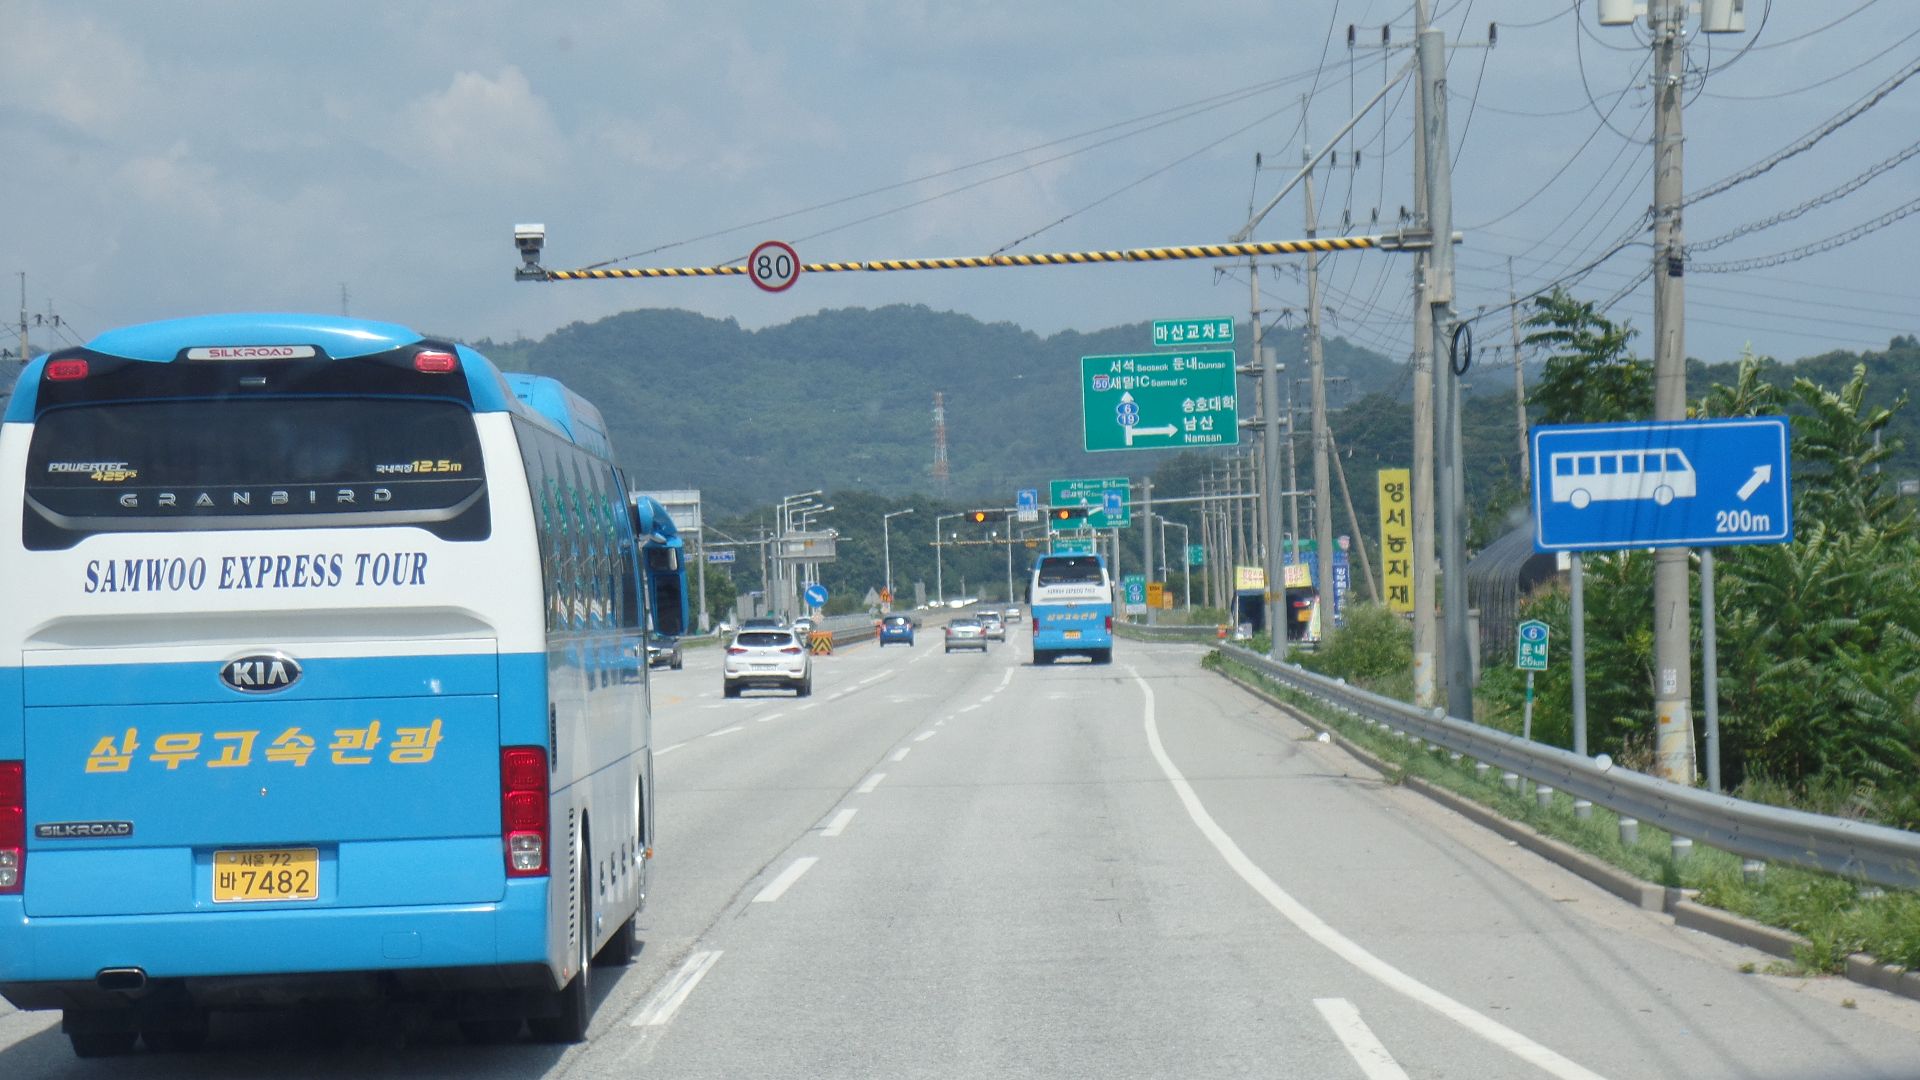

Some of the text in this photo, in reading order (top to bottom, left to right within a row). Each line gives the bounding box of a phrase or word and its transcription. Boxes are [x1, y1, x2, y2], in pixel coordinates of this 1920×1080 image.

[757, 254, 791, 280] 80
[1156, 322, 1232, 341] 마산교차로
[208, 347, 294, 359] SILKROAD
[1110, 359, 1135, 373] 서석
[1173, 357, 1198, 371] 둔내
[1095, 379, 1108, 390] 50
[1110, 375, 1150, 390] 새말IC
[1124, 403, 1132, 414] 6
[1182, 395, 1235, 413] 송호대학
[1121, 413, 1135, 422] 19
[1183, 415, 1214, 432] 남산
[1184, 433, 1222, 443] Namsan
[48, 462, 128, 473] POWERTEC
[91, 469, 138, 482] 425PS
[119, 487, 393, 508] GRANBIRD
[1716, 510, 1770, 533] 200m
[1385, 483, 1409, 604] 영서농자재
[84, 551, 428, 593] SAMWOO EXPRESS TOUR
[1530, 627, 1538, 639] 6
[1522, 643, 1546, 656] 둔내
[1520, 656, 1545, 666] 26km
[233, 661, 289, 685] KIA
[84, 718, 443, 774] 삼우고속관광
[39, 823, 131, 837] SILKROAD
[240, 853, 292, 867] 서울 72
